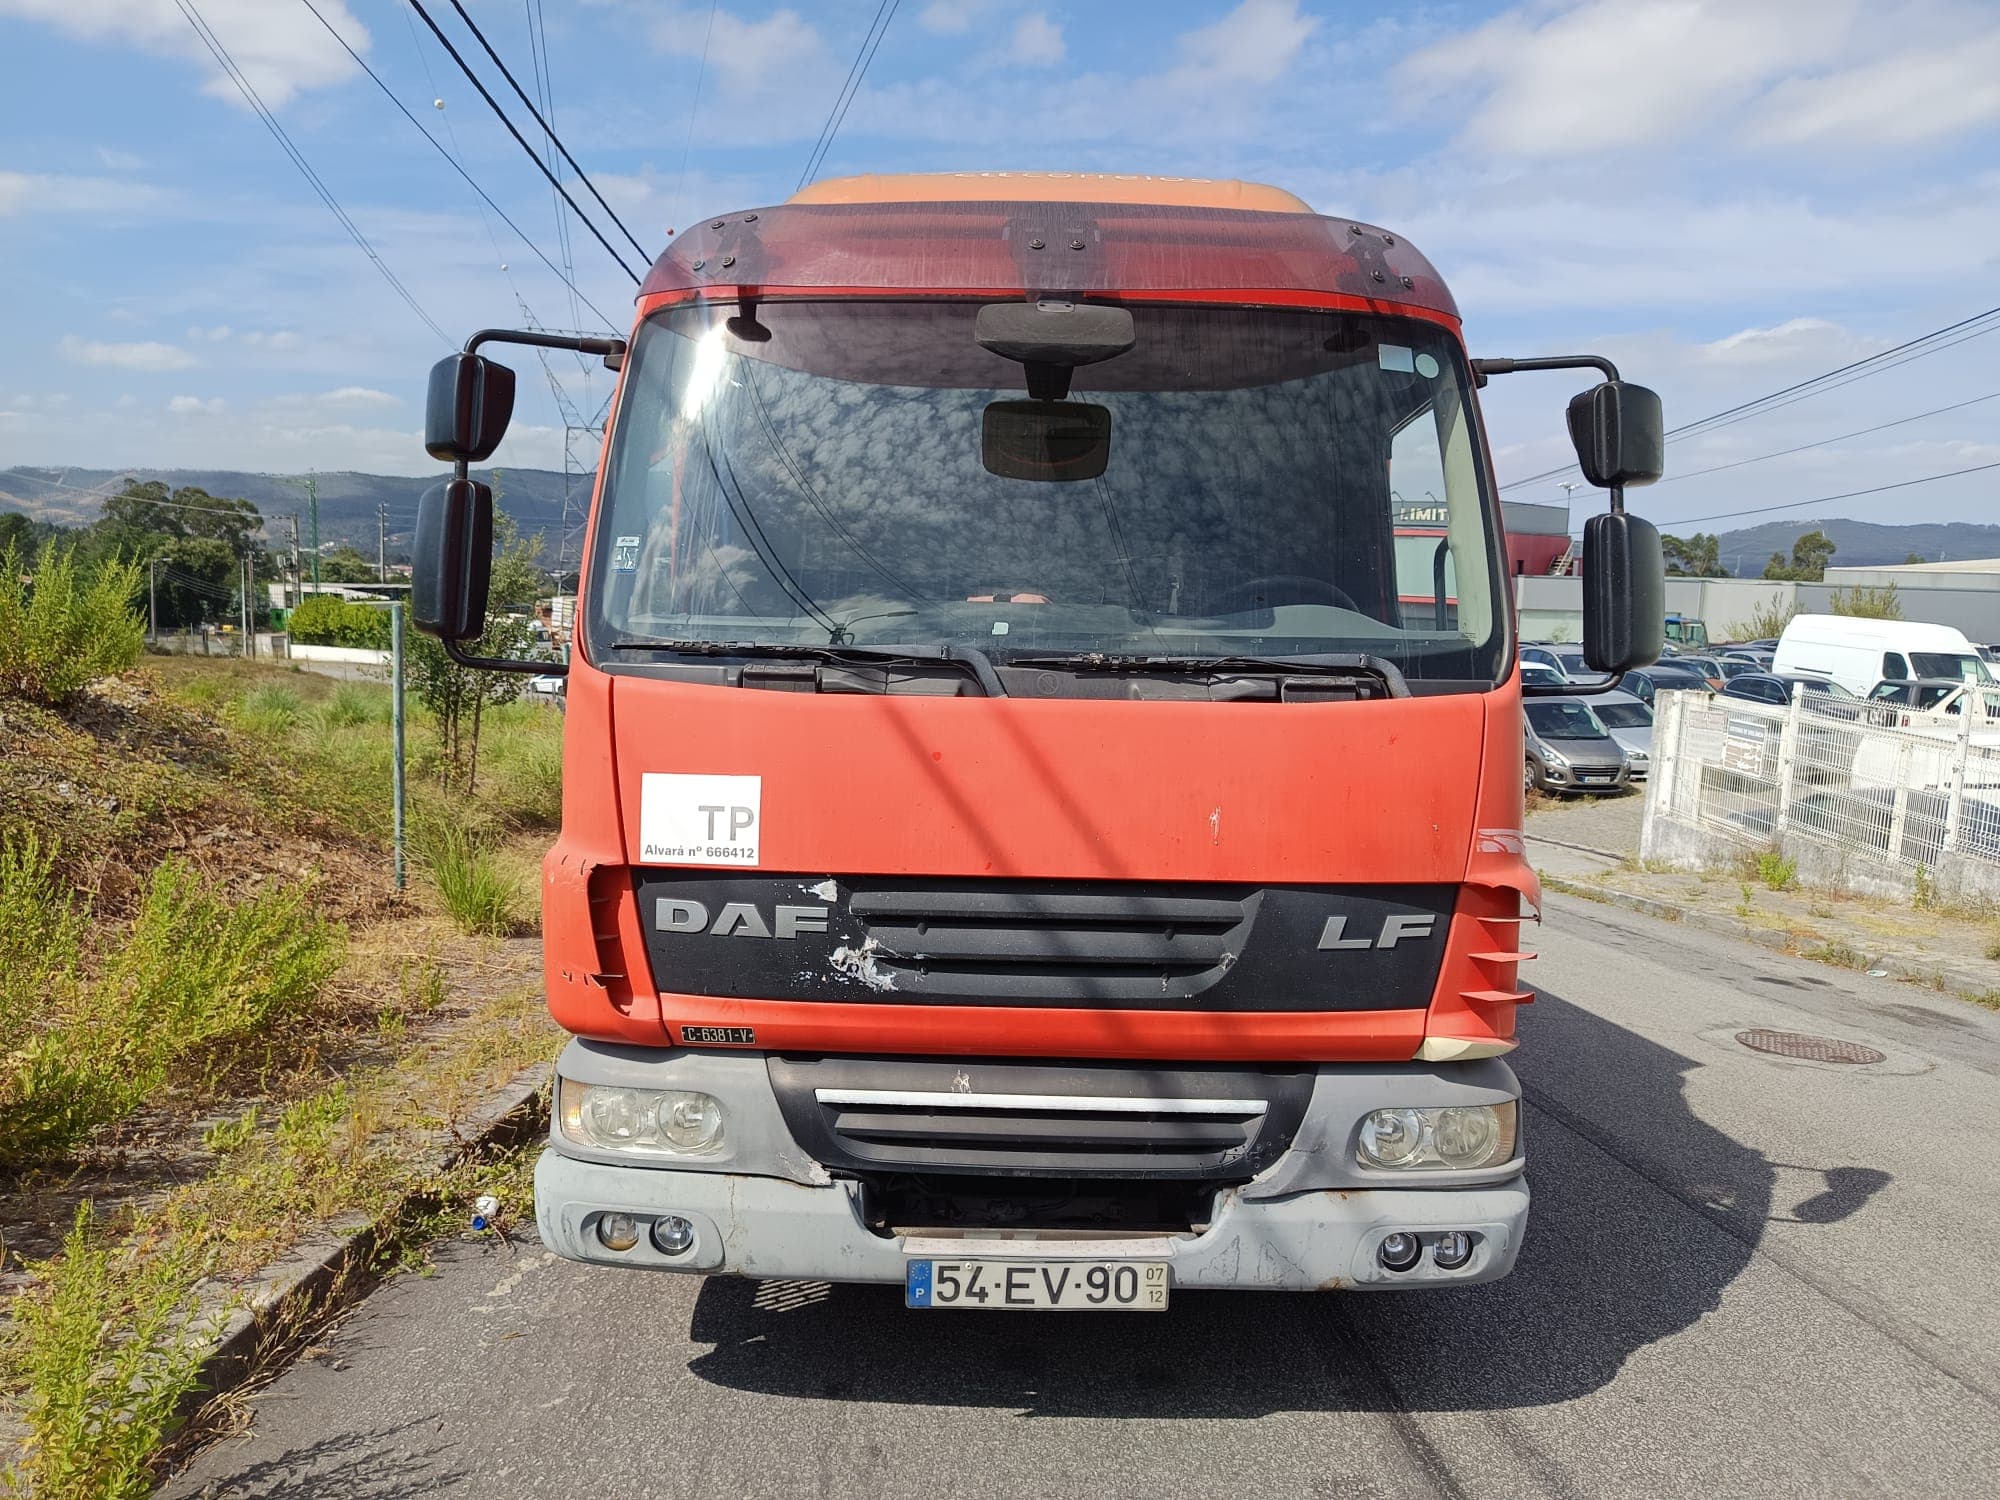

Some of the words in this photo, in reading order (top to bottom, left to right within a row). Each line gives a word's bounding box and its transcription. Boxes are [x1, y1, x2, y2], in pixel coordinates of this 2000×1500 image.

[698, 805, 755, 841] TP
[644, 844, 684, 856] Alvará
[706, 847, 754, 858] 666412
[656, 898, 828, 938] DAF
[1317, 914, 1435, 949] LF
[1146, 1268, 1164, 1281] 07
[915, 1287, 925, 1299] P
[1148, 1290, 1163, 1303] 12
